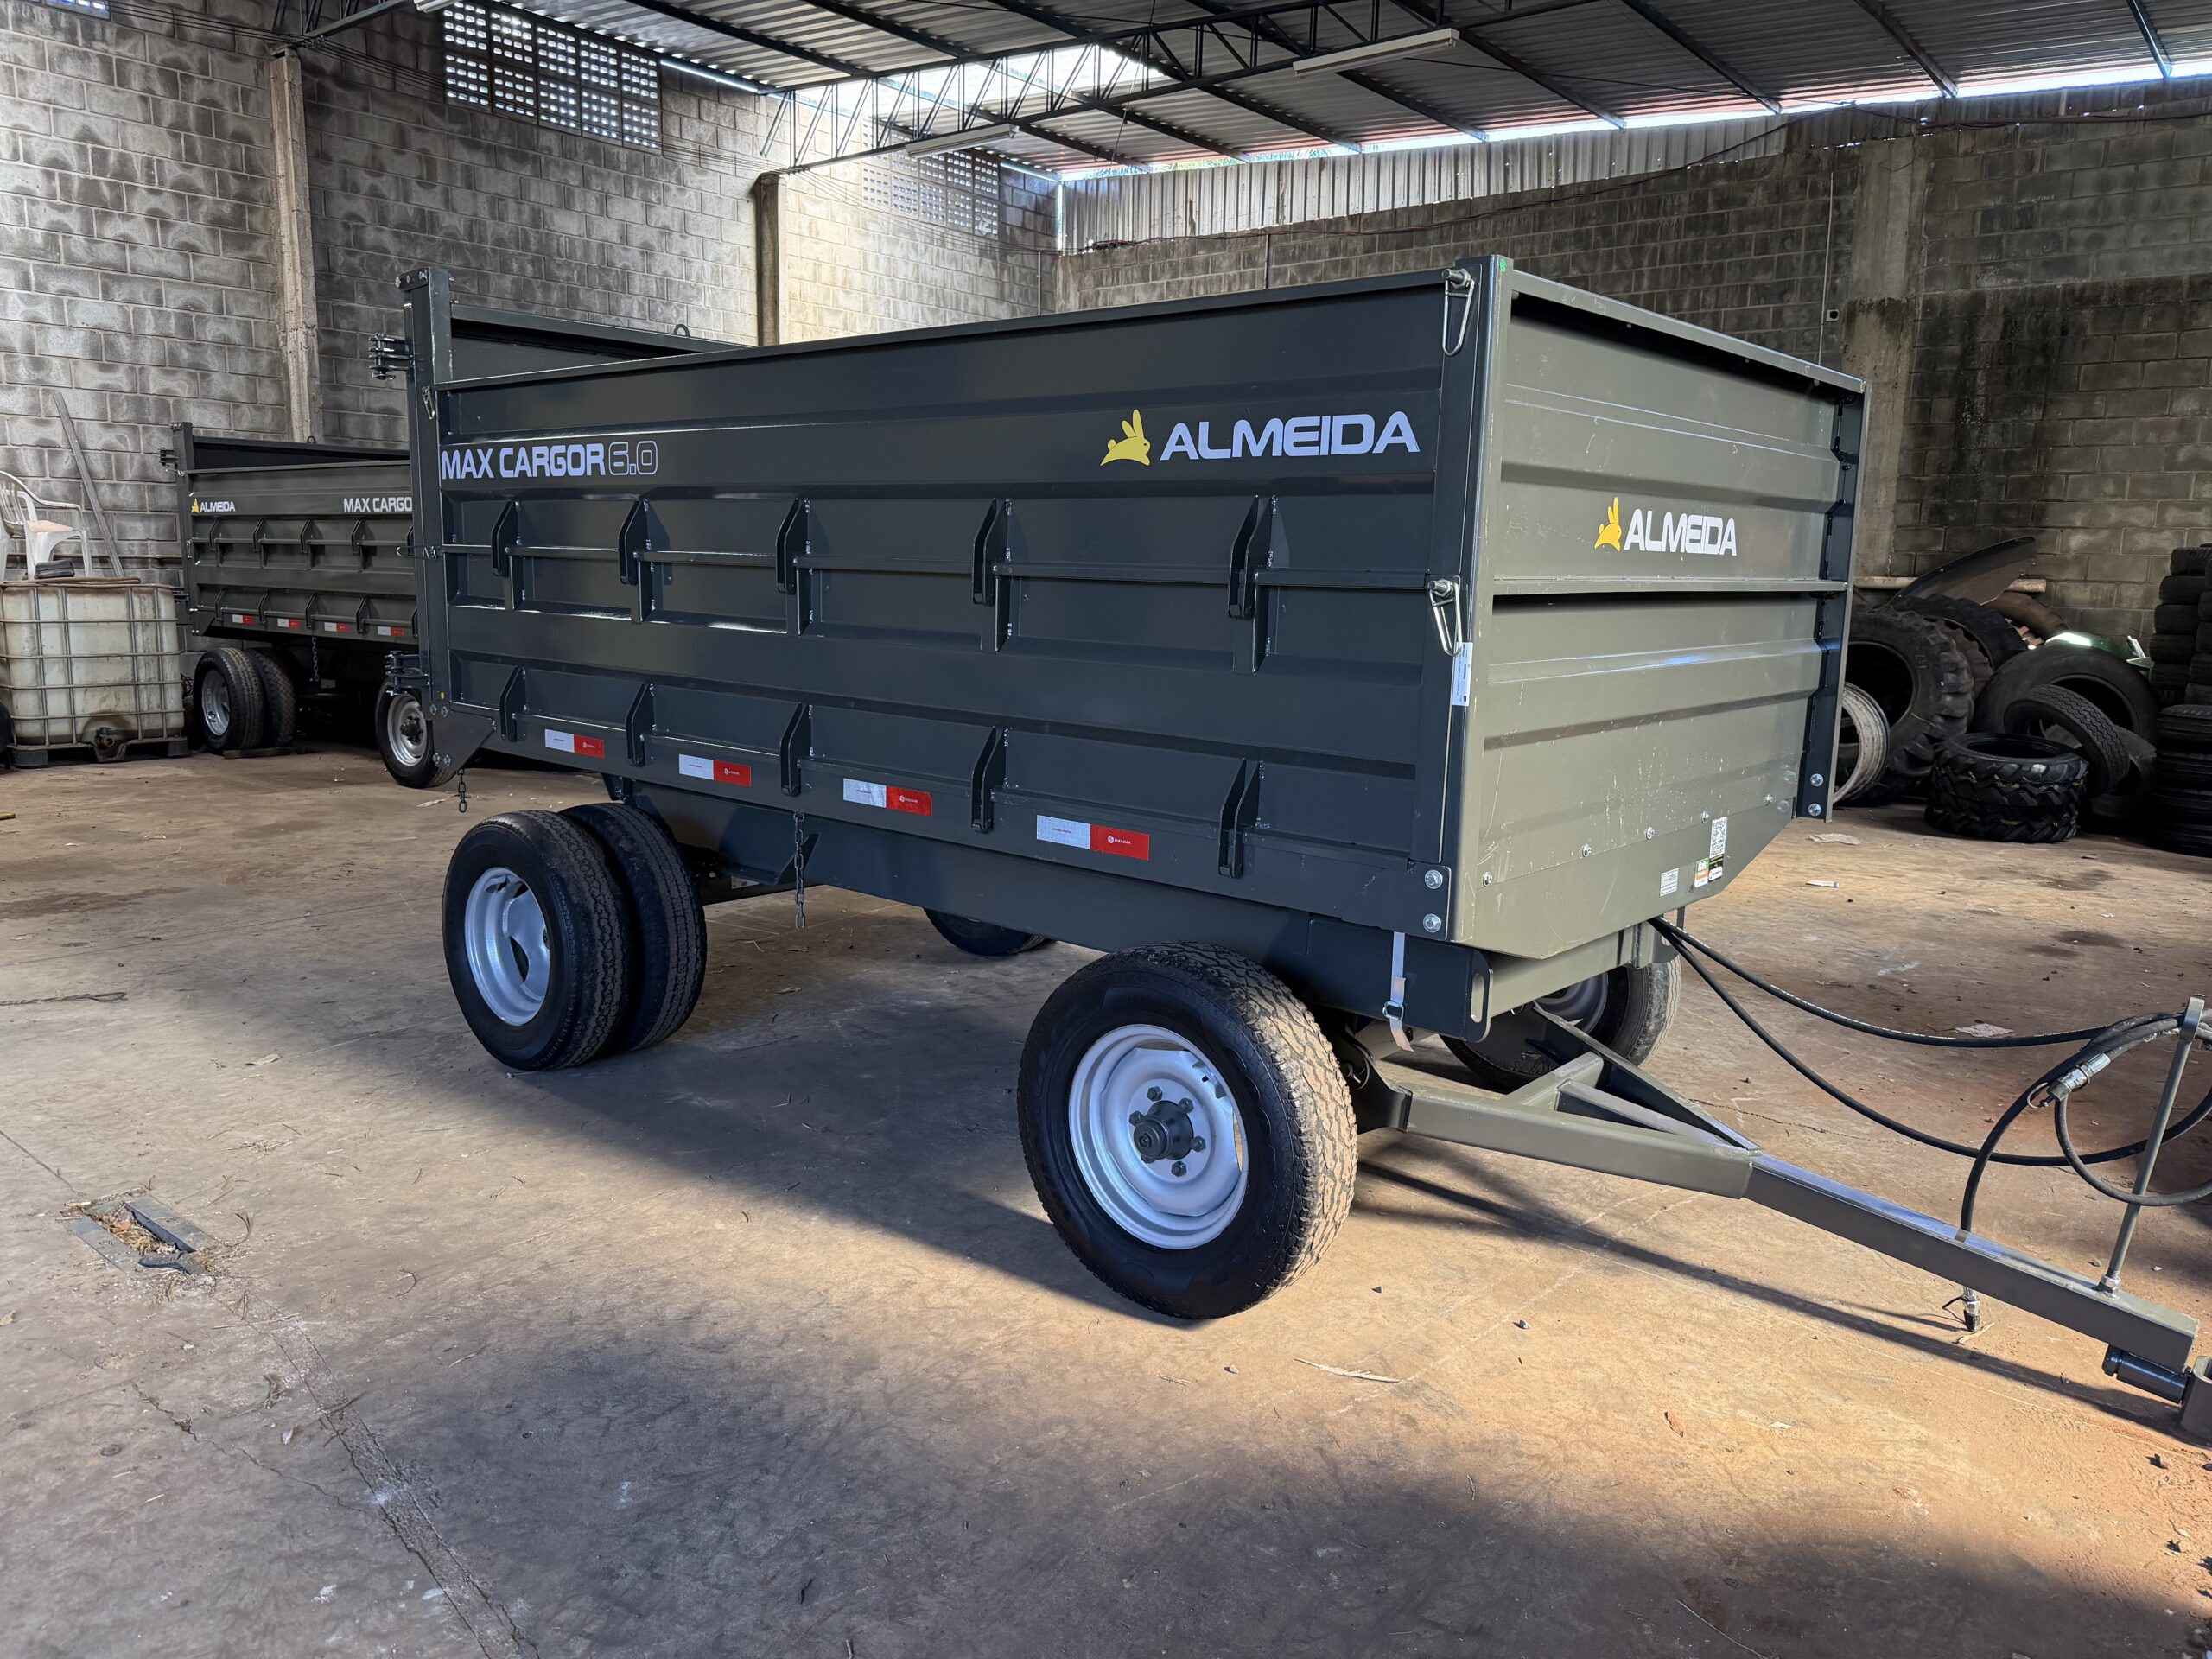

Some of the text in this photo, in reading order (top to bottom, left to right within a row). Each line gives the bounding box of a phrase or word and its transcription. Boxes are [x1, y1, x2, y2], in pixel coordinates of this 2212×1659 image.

[1160, 410, 1420, 461] ALMEIDA
[442, 441, 658, 480] MAX CARGOR 6.0
[200, 501, 236, 512] ALMEIDA
[343, 497, 371, 512] MAX
[1624, 508, 1738, 556] ALMEIDA
